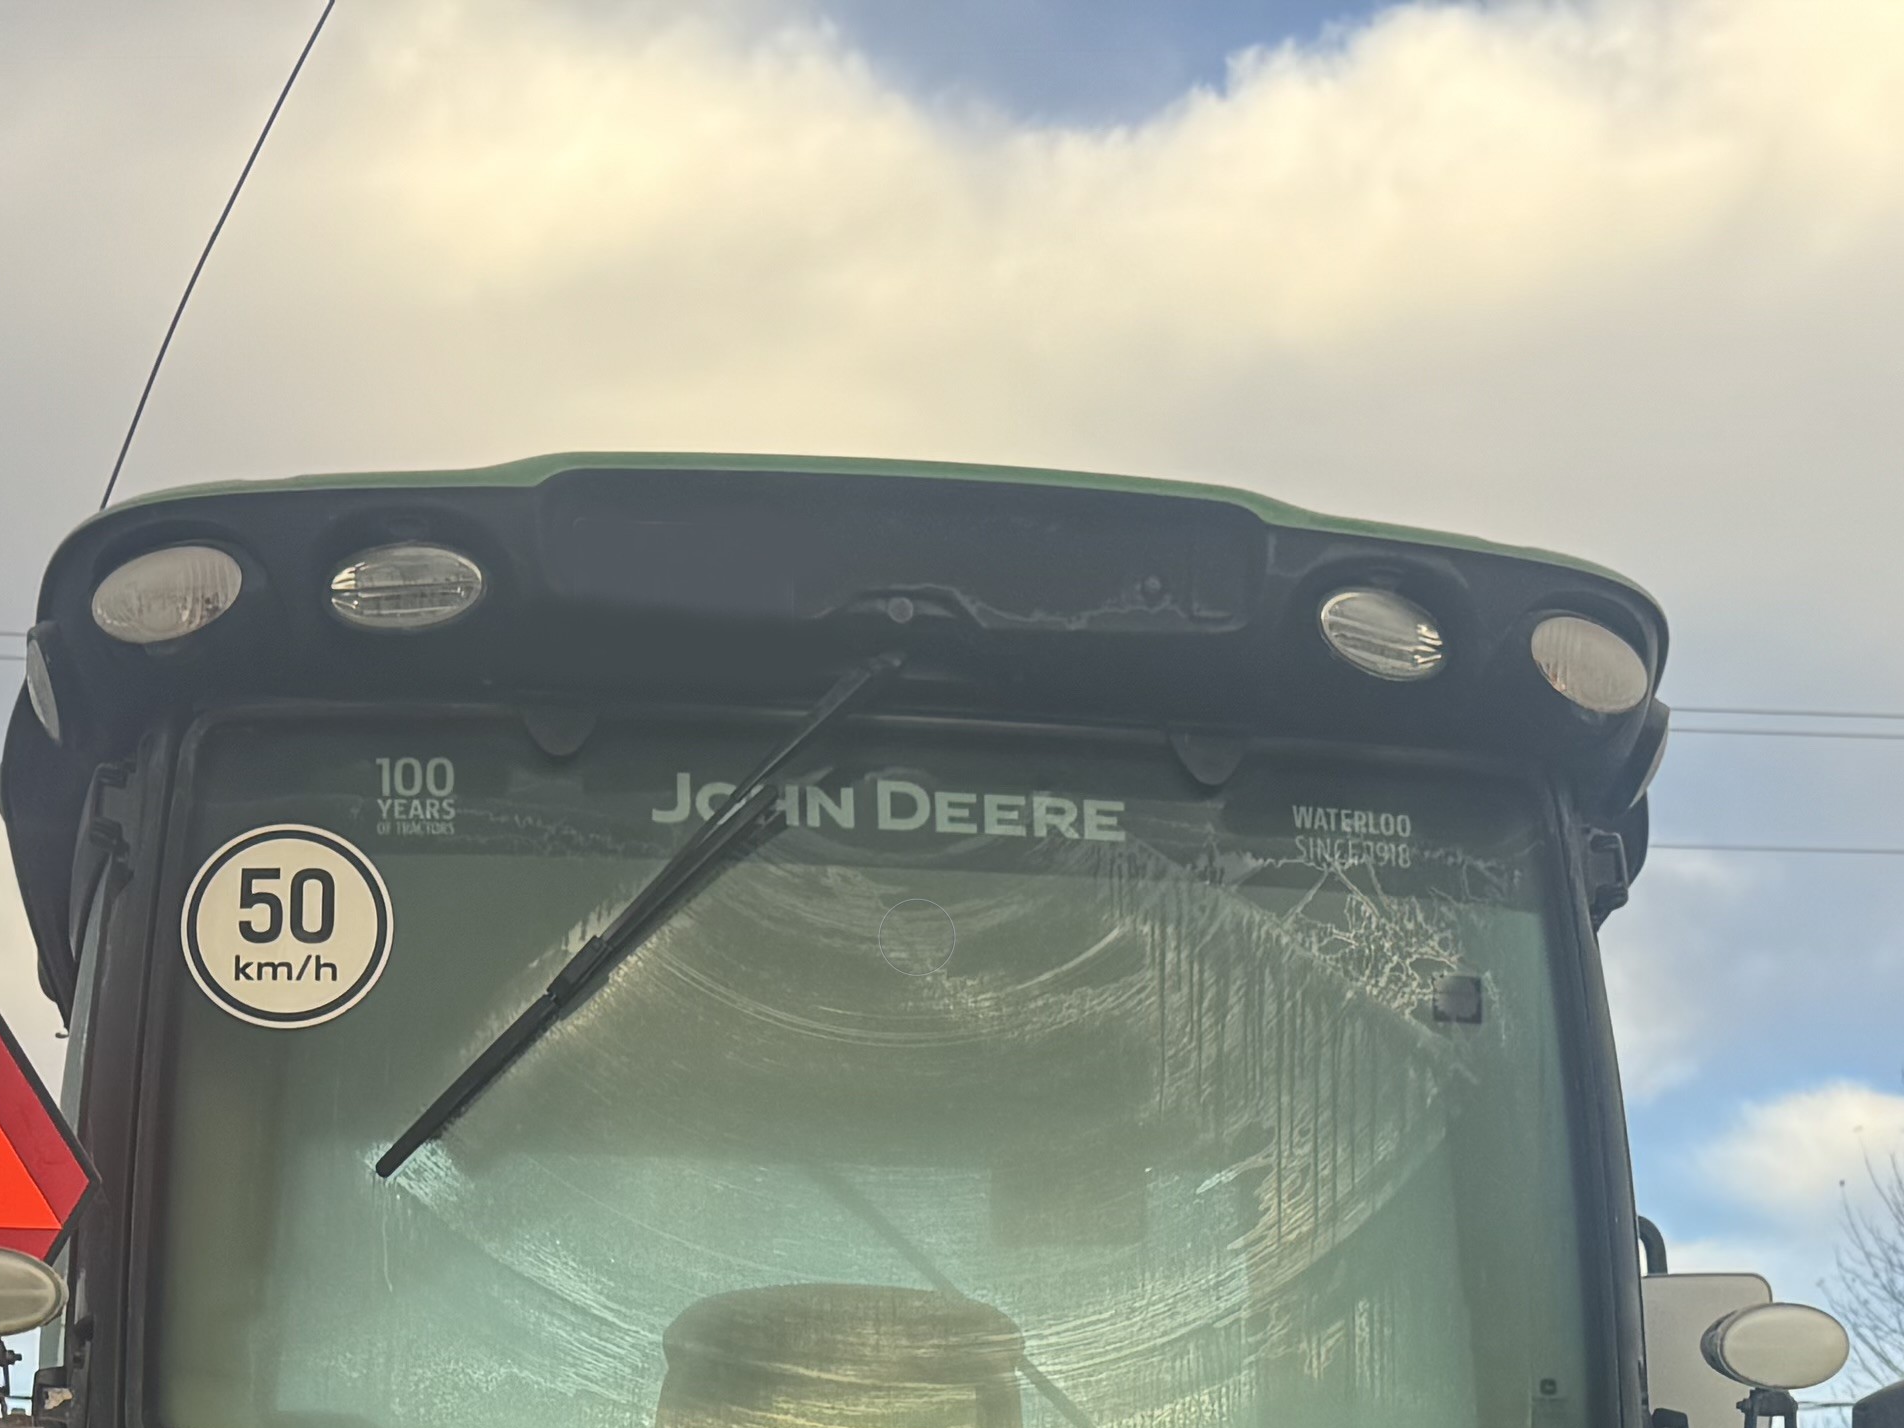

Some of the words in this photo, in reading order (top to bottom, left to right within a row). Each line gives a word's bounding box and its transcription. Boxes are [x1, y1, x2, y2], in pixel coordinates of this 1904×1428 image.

[376, 757, 455, 797] 100
[377, 798, 456, 820] YEARS
[876, 780, 1126, 842] DEERE
[1292, 805, 1411, 838] WATERLOO
[1296, 836, 1360, 866] SINCE
[238, 867, 336, 945] 50
[234, 954, 338, 982] km/h
